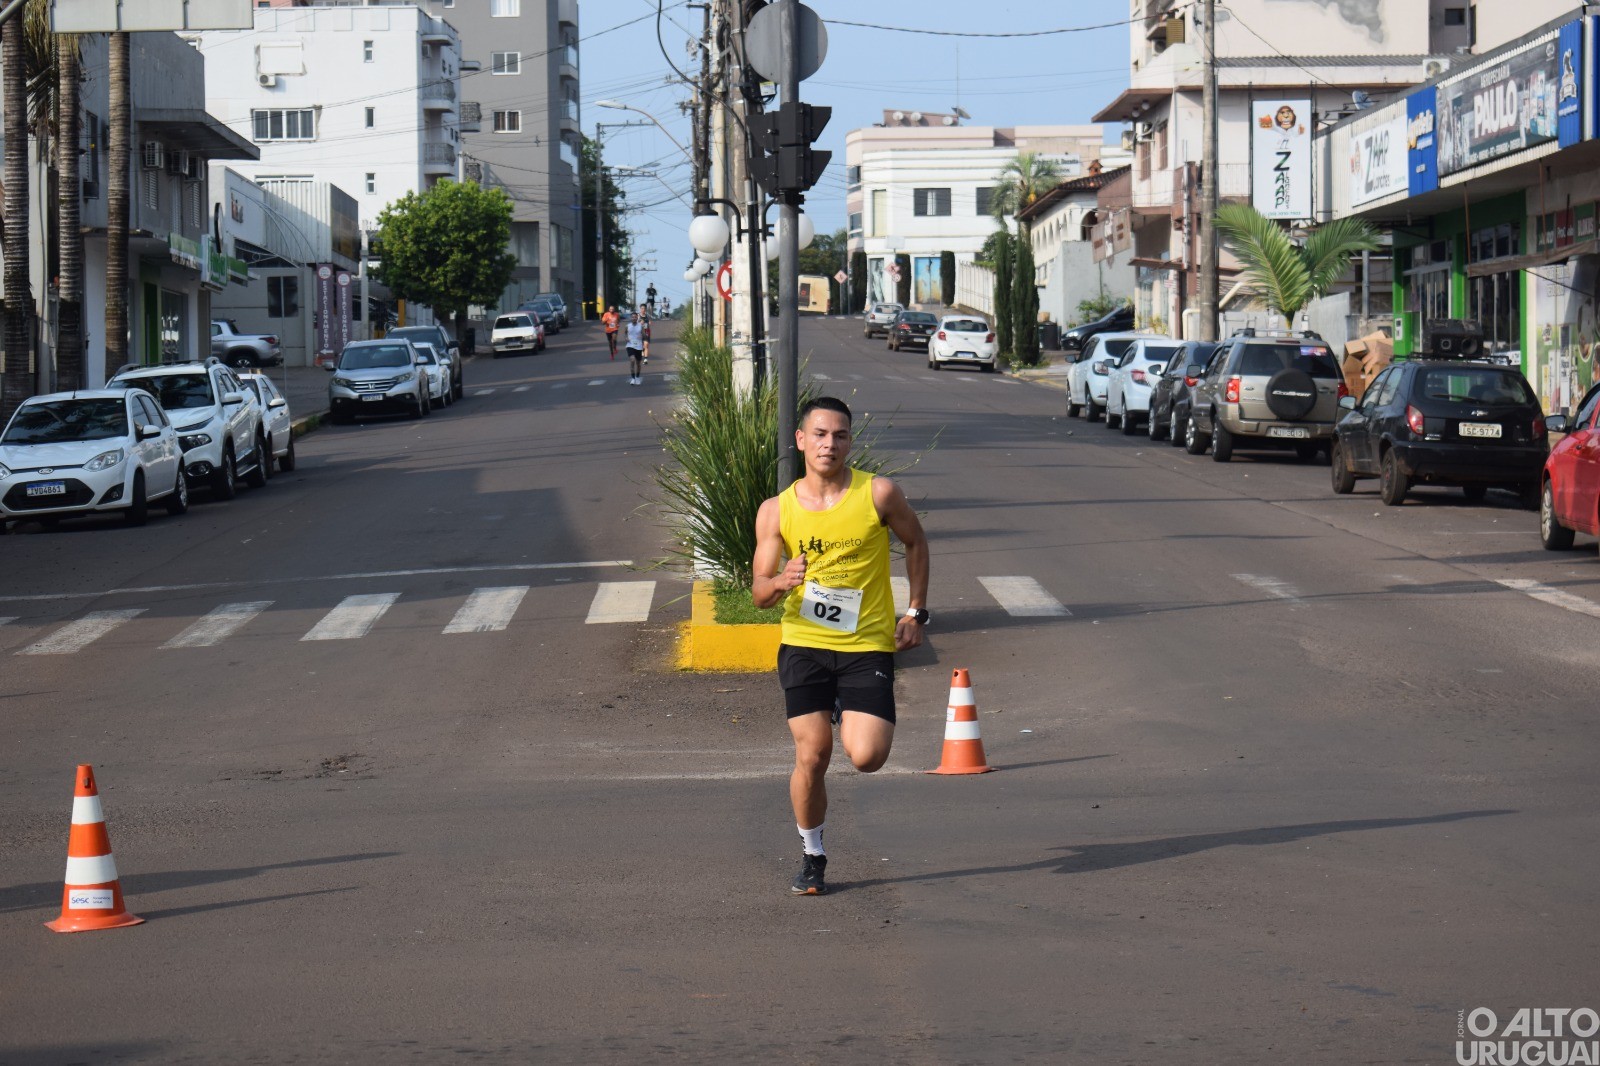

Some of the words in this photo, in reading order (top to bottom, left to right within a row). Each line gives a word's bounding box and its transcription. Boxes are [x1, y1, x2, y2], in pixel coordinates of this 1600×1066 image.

[1474, 80, 1517, 138] PAULO
[1273, 151, 1292, 209] ZAAP
[1364, 129, 1389, 194] ZAAP
[824, 537, 862, 551] Projeto
[836, 553, 859, 565] Correr
[814, 602, 842, 623] 02
